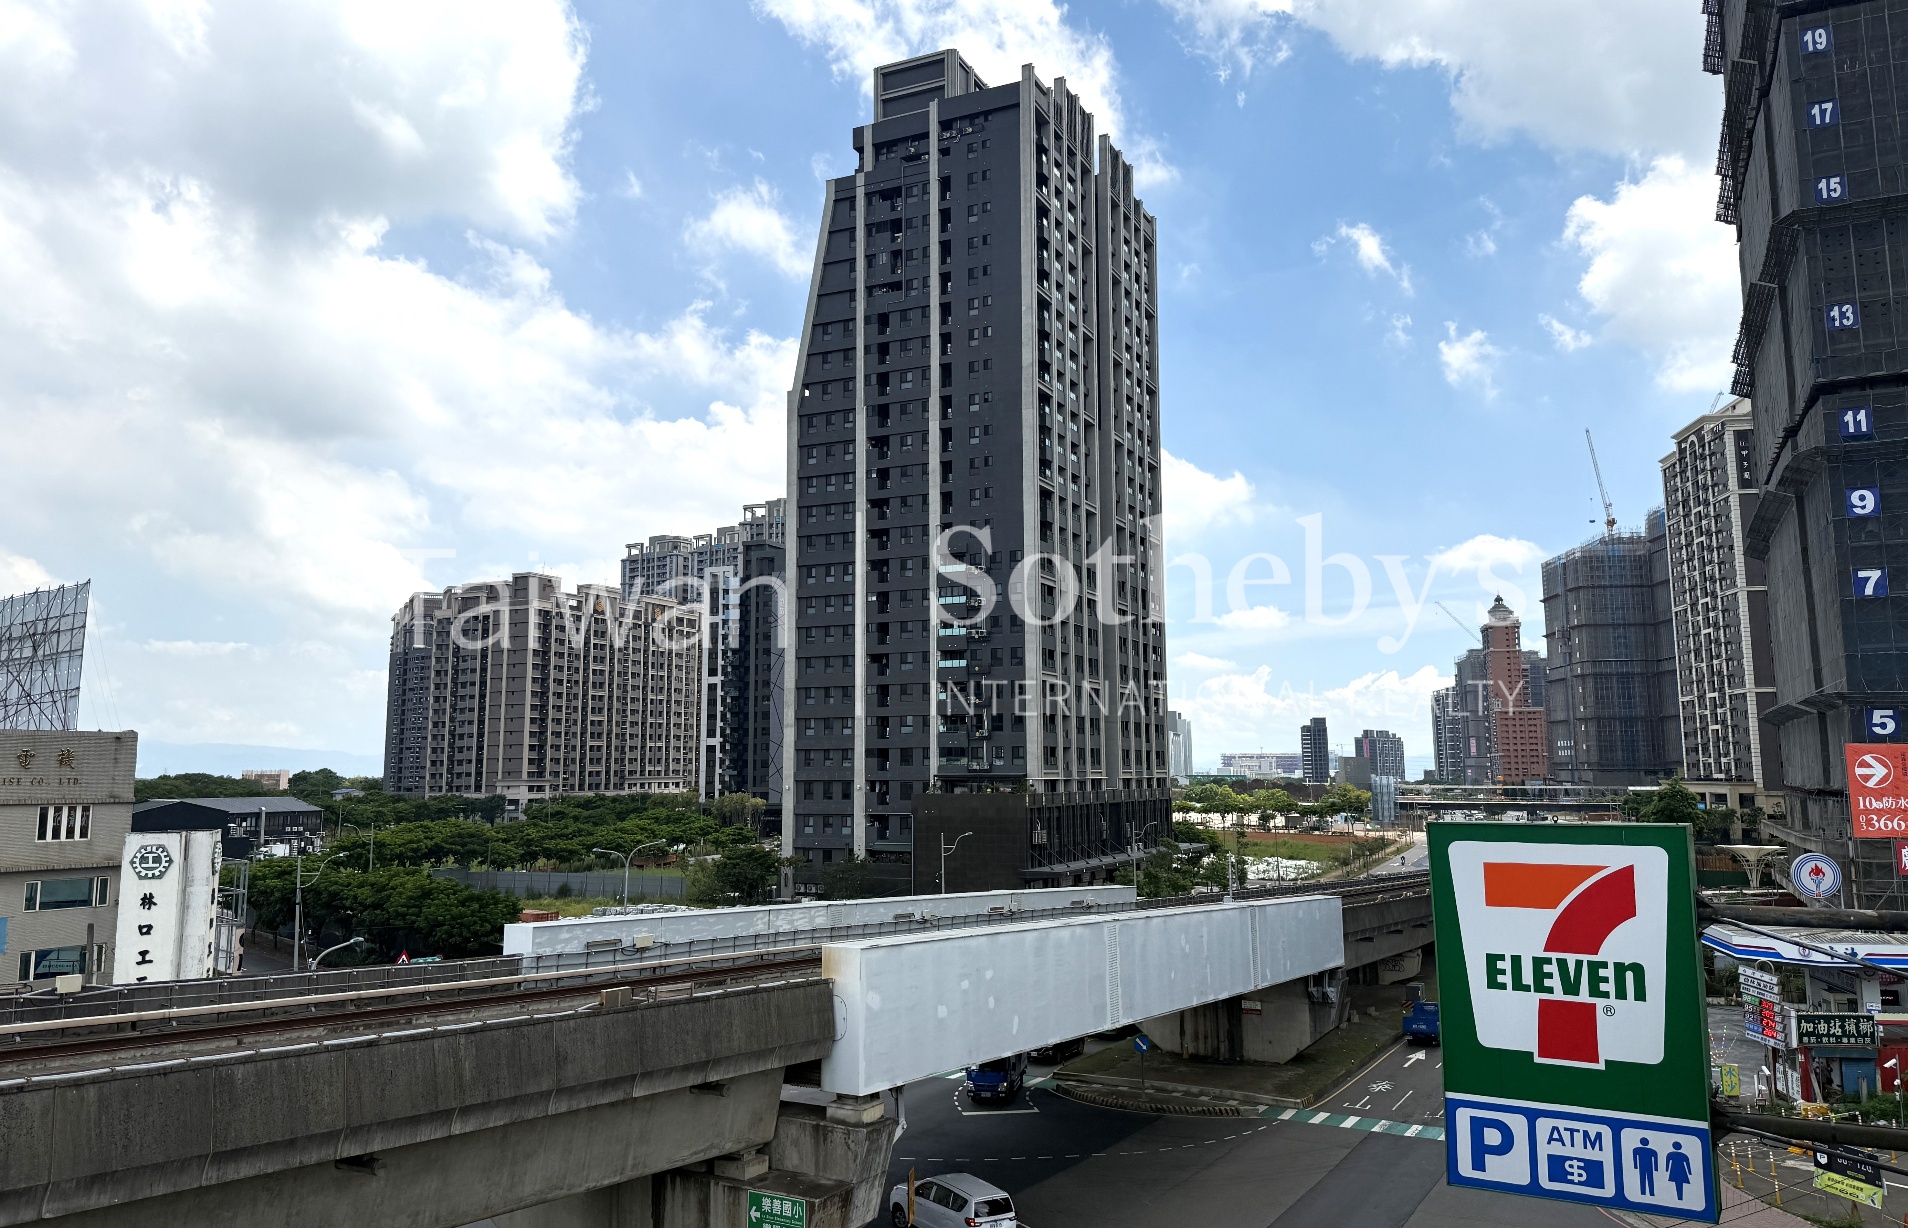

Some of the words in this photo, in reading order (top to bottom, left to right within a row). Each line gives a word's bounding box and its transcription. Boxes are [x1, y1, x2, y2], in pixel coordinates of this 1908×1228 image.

[1803, 28, 1828, 51] 19
[1811, 102, 1833, 125] 17
[1818, 176, 1841, 198] 15
[1830, 305, 1854, 326] 13
[1843, 409, 1868, 433] 11
[1850, 489, 1875, 514] 9
[1857, 569, 1882, 596] 7
[1872, 709, 1896, 735] 5
[59, 777, 82, 786] LTD.
[1483, 861, 1637, 1065] 7
[1485, 952, 1647, 1003] ELEVEn
[1469, 1115, 1515, 1173] P
[1546, 1125, 1603, 1152] ATM
[1564, 1159, 1587, 1183] $
[762, 1197, 802, 1218] 樂善國小
